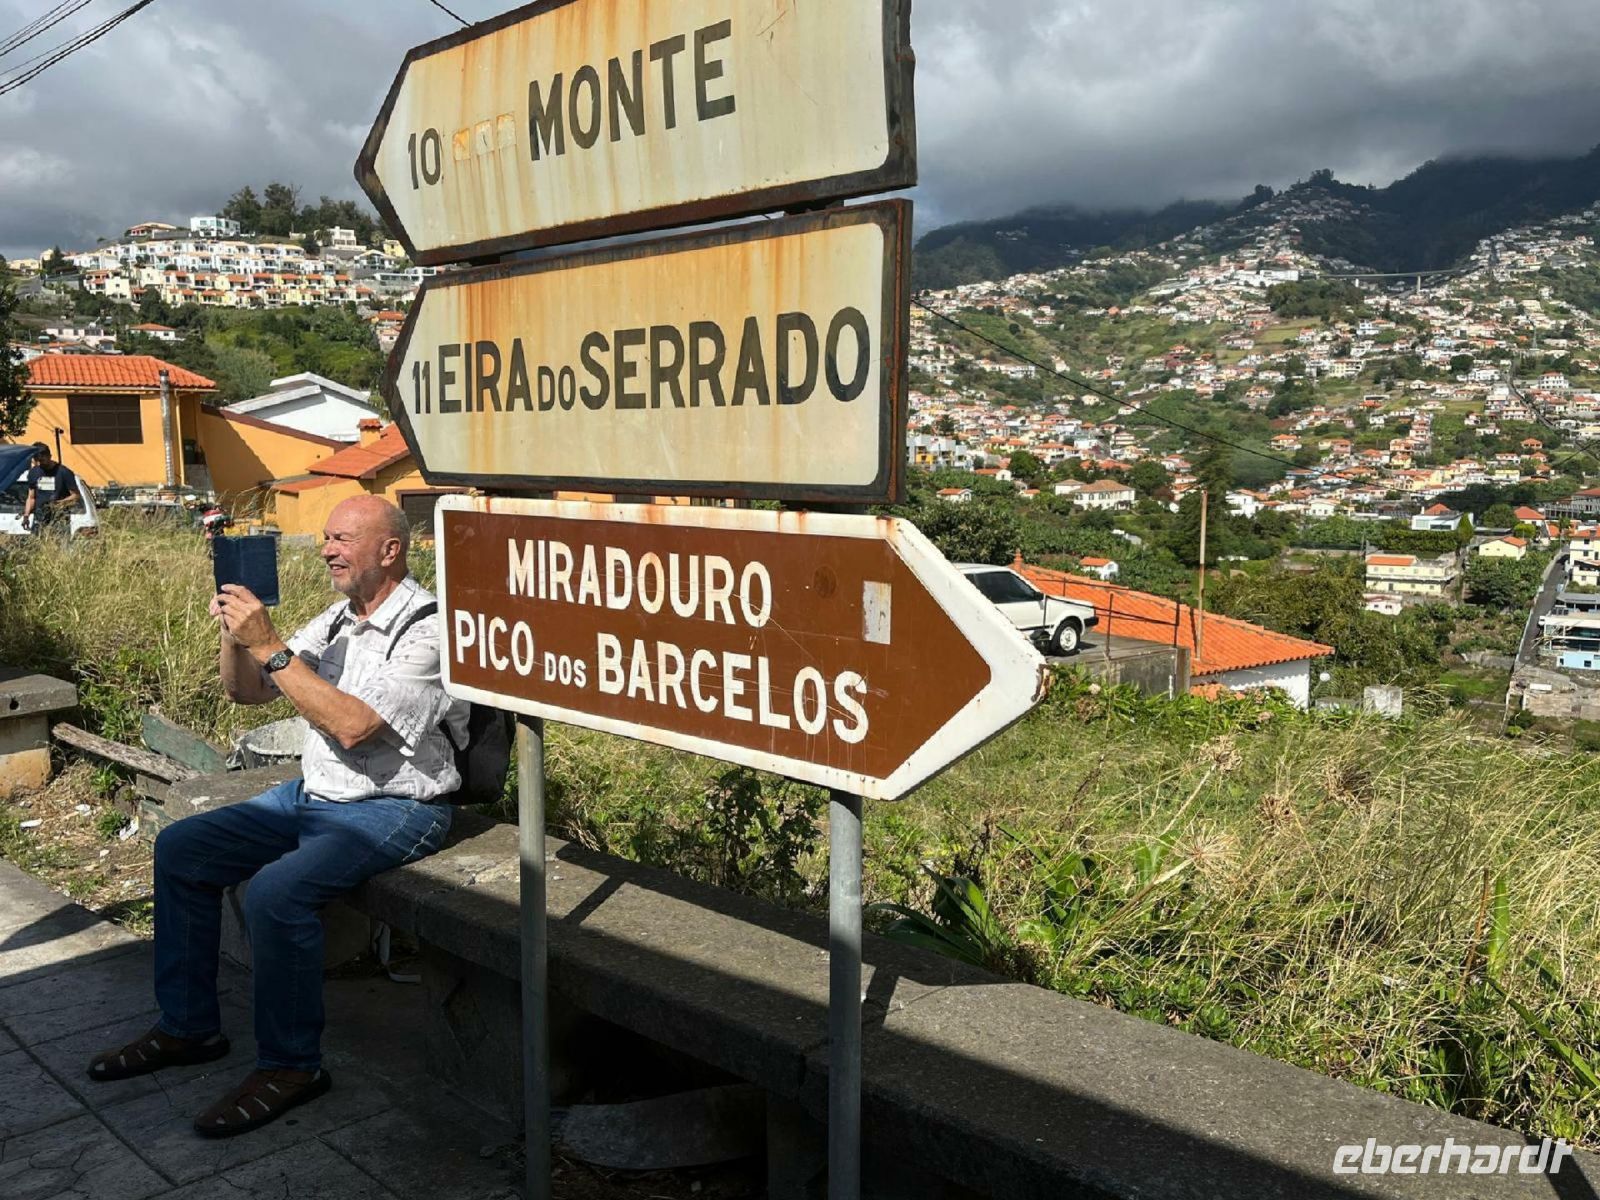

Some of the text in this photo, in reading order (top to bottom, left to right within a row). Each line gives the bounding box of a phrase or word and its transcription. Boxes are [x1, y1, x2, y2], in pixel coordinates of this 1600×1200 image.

[408, 19, 736, 189] 10 MONTE
[413, 306, 870, 414] 11 EIRA DO SERRADO
[507, 538, 772, 628] MIRADOURO
[455, 610, 869, 744] PICO DOS BARCELOS
